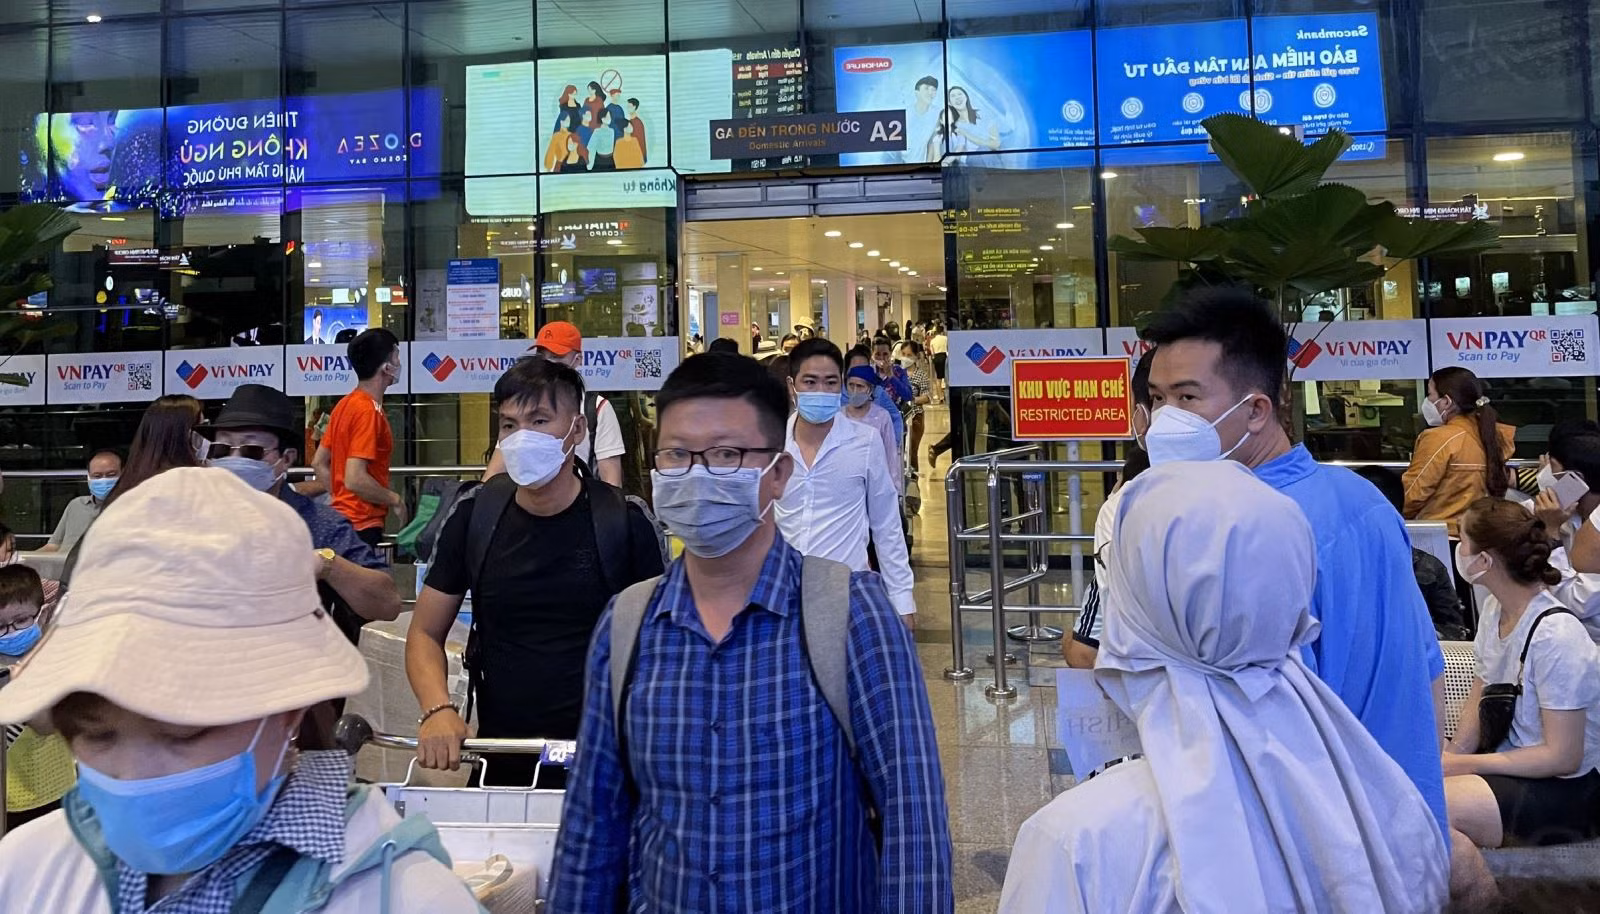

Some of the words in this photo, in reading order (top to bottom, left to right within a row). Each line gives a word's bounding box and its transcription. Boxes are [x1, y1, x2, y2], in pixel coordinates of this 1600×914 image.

[715, 128, 734, 139] GA
[738, 122, 766, 138] ĐẾN
[771, 122, 816, 137] TRONG
[821, 118, 860, 135] NƯỚC
[869, 120, 903, 142] A2
[748, 139, 790, 150] Domestic
[791, 138, 826, 148] Arrivals
[1325, 341, 1344, 356] Ví
[1347, 340, 1412, 356] VNPAY
[1458, 351, 1483, 361] Scan
[1487, 352, 1498, 361] to
[1500, 351, 1520, 363] Pay
[211, 365, 225, 378] Ví
[227, 363, 275, 378] VNPAY
[460, 358, 475, 371] Ví
[477, 357, 520, 371] VNPA
[304, 372, 322, 383] Scan
[324, 372, 333, 382] to
[335, 372, 350, 383] Pay
[595, 368, 611, 378] Pay
[64, 382, 82, 392] Scan
[83, 382, 91, 391] to
[92, 381, 107, 392] Pay
[1019, 379, 1043, 399] KHU
[1046, 377, 1071, 402] VỰC
[1073, 379, 1098, 402] HẠN
[1101, 372, 1125, 399] CHẾ
[1019, 408, 1092, 421] RESTRICTED
[1094, 408, 1126, 420] AREA
